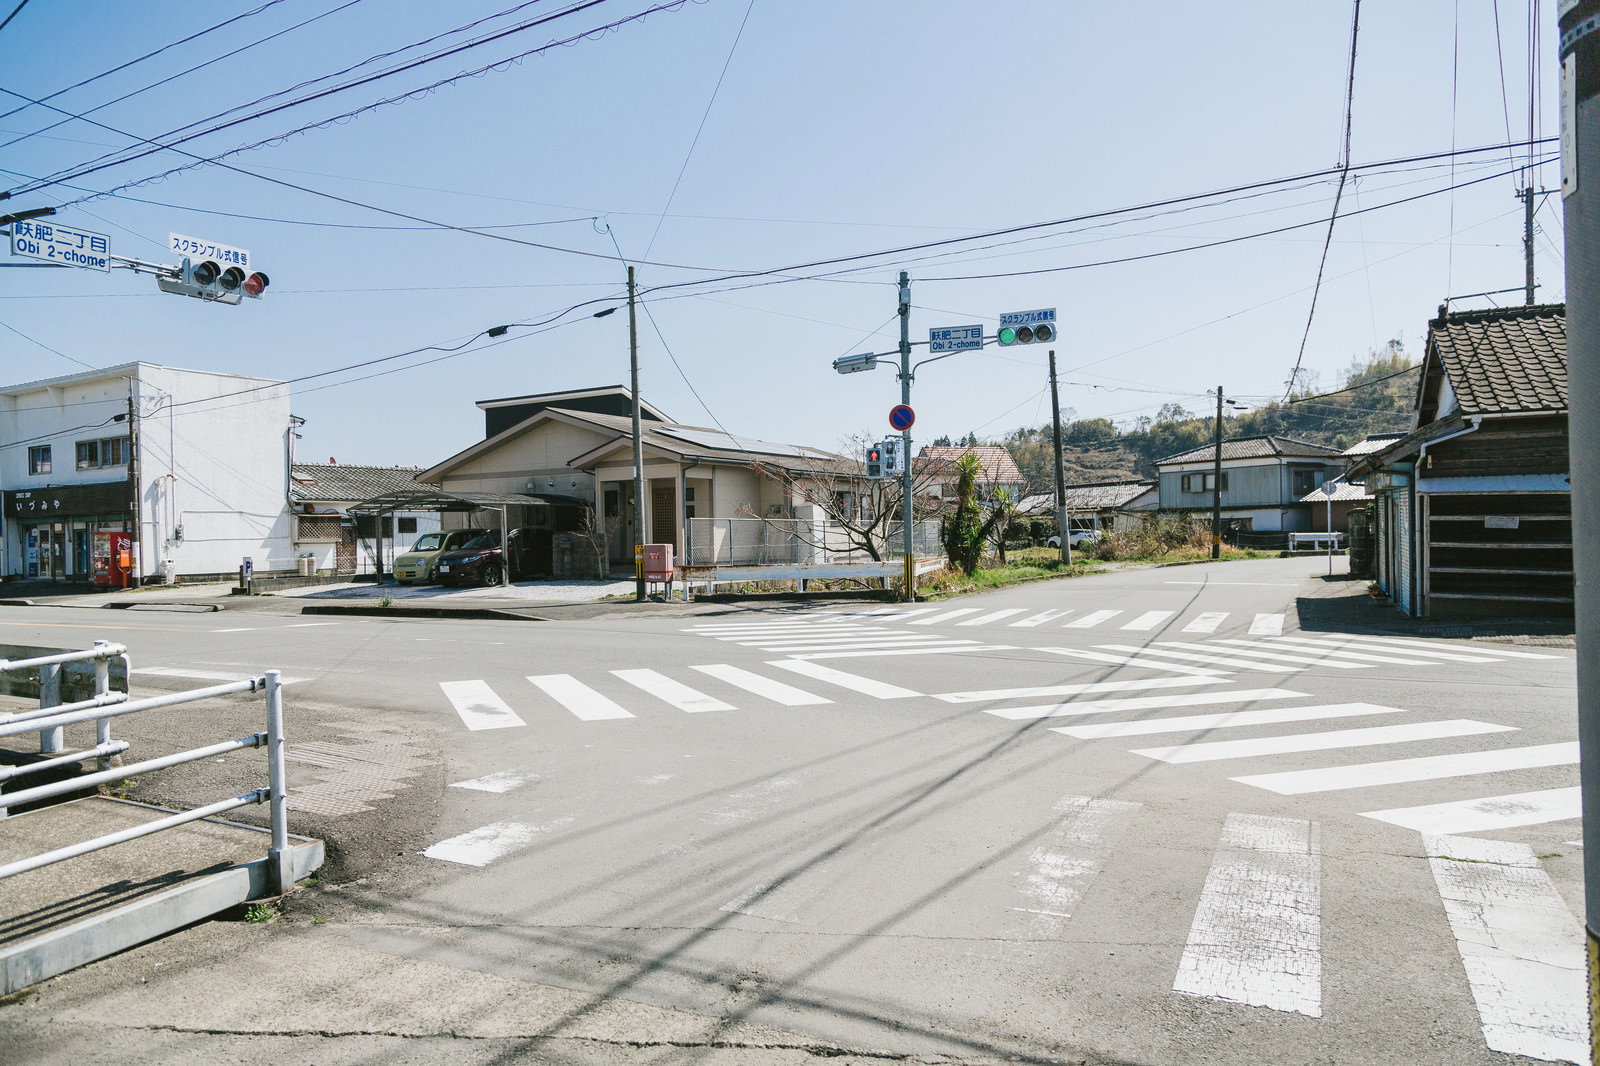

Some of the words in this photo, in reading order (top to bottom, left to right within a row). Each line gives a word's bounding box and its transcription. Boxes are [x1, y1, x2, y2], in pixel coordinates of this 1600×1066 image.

[16, 238, 40, 254] Obi
[47, 245, 106, 268] 2-chome
[173, 237, 248, 266] スクランブル式信号
[1001, 310, 1055, 325] スクランブル式信号
[931, 328, 981, 341] 飫肥二丁目
[932, 341, 945, 350] Obi
[948, 340, 980, 349] 2-chome
[16, 499, 60, 511] いづみや
[245, 560, 251, 574] P
